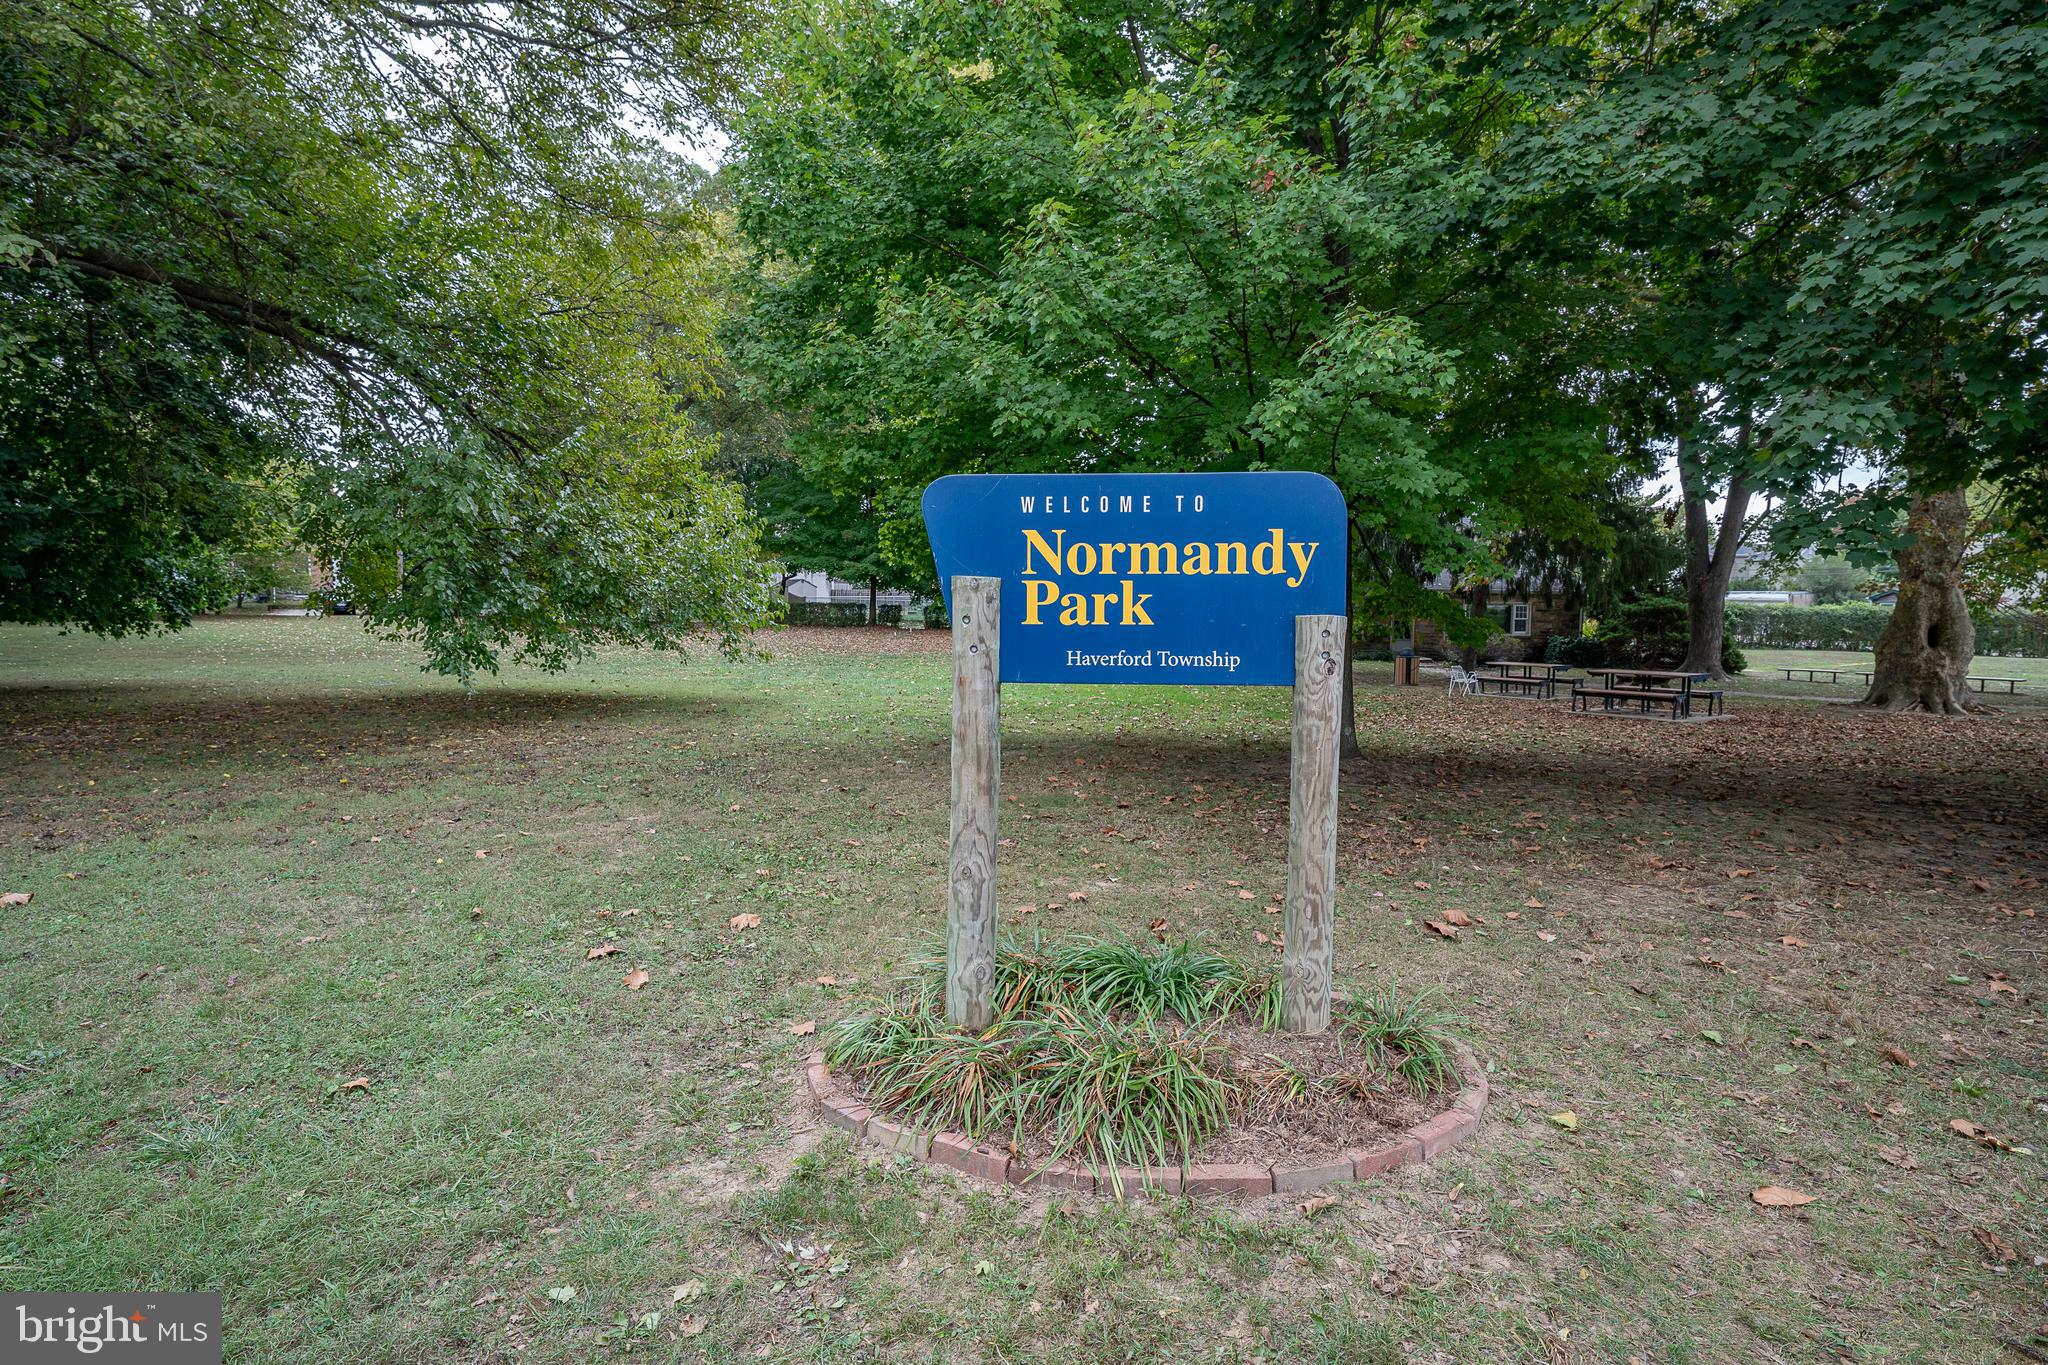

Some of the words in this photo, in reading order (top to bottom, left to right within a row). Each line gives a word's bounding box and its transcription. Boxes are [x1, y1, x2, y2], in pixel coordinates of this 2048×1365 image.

[1020, 495, 1151, 514] WELCOME
[1175, 494, 1204, 513] TO
[1021, 528, 1320, 588] Normandy
[1021, 580, 1155, 626] Park
[1066, 649, 1153, 668] Haverford
[1156, 650, 1241, 673] Township
